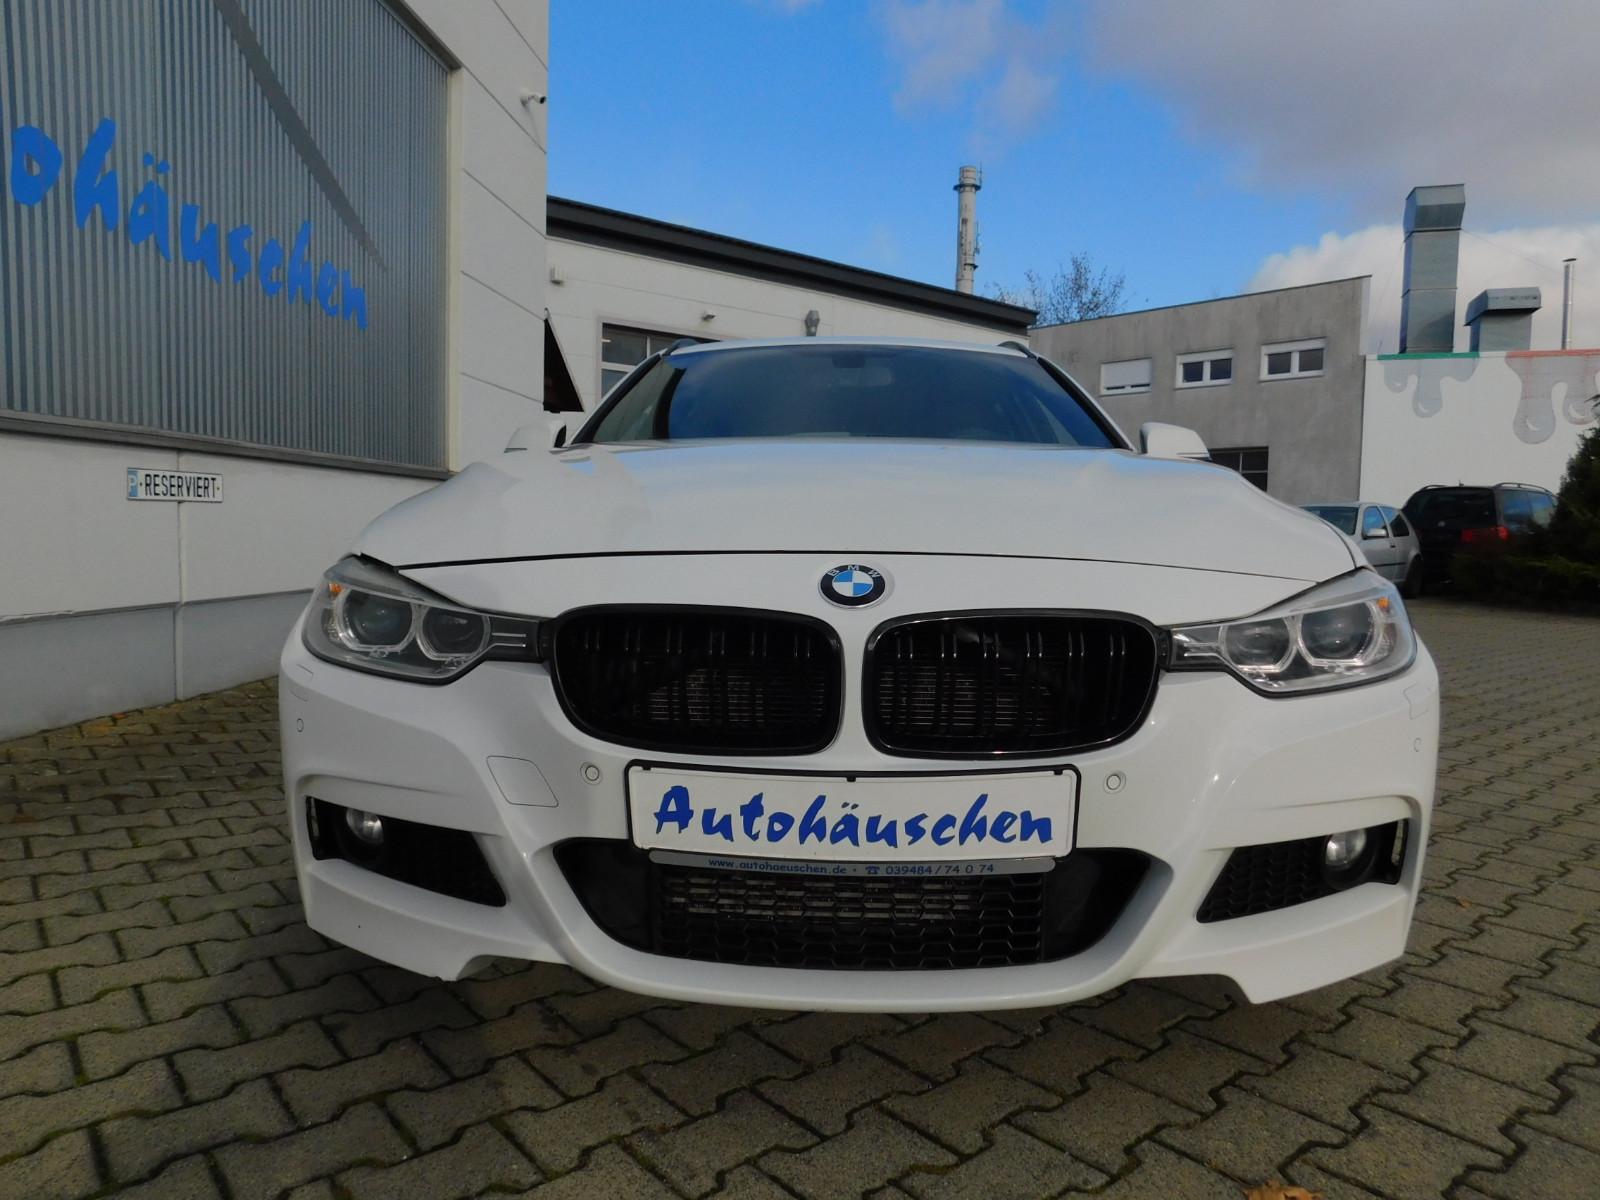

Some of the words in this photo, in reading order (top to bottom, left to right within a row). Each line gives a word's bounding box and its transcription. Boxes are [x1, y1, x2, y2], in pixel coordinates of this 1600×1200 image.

[9, 117, 368, 330] ohäuschen
[144, 473, 217, 498] RESERVIERT
[827, 564, 881, 578] BMW
[653, 785, 1053, 848] Autohäuschen
[708, 857, 847, 875] www.autohaeuschen.de
[965, 864, 974, 874] 0
[979, 863, 995, 874] 74
